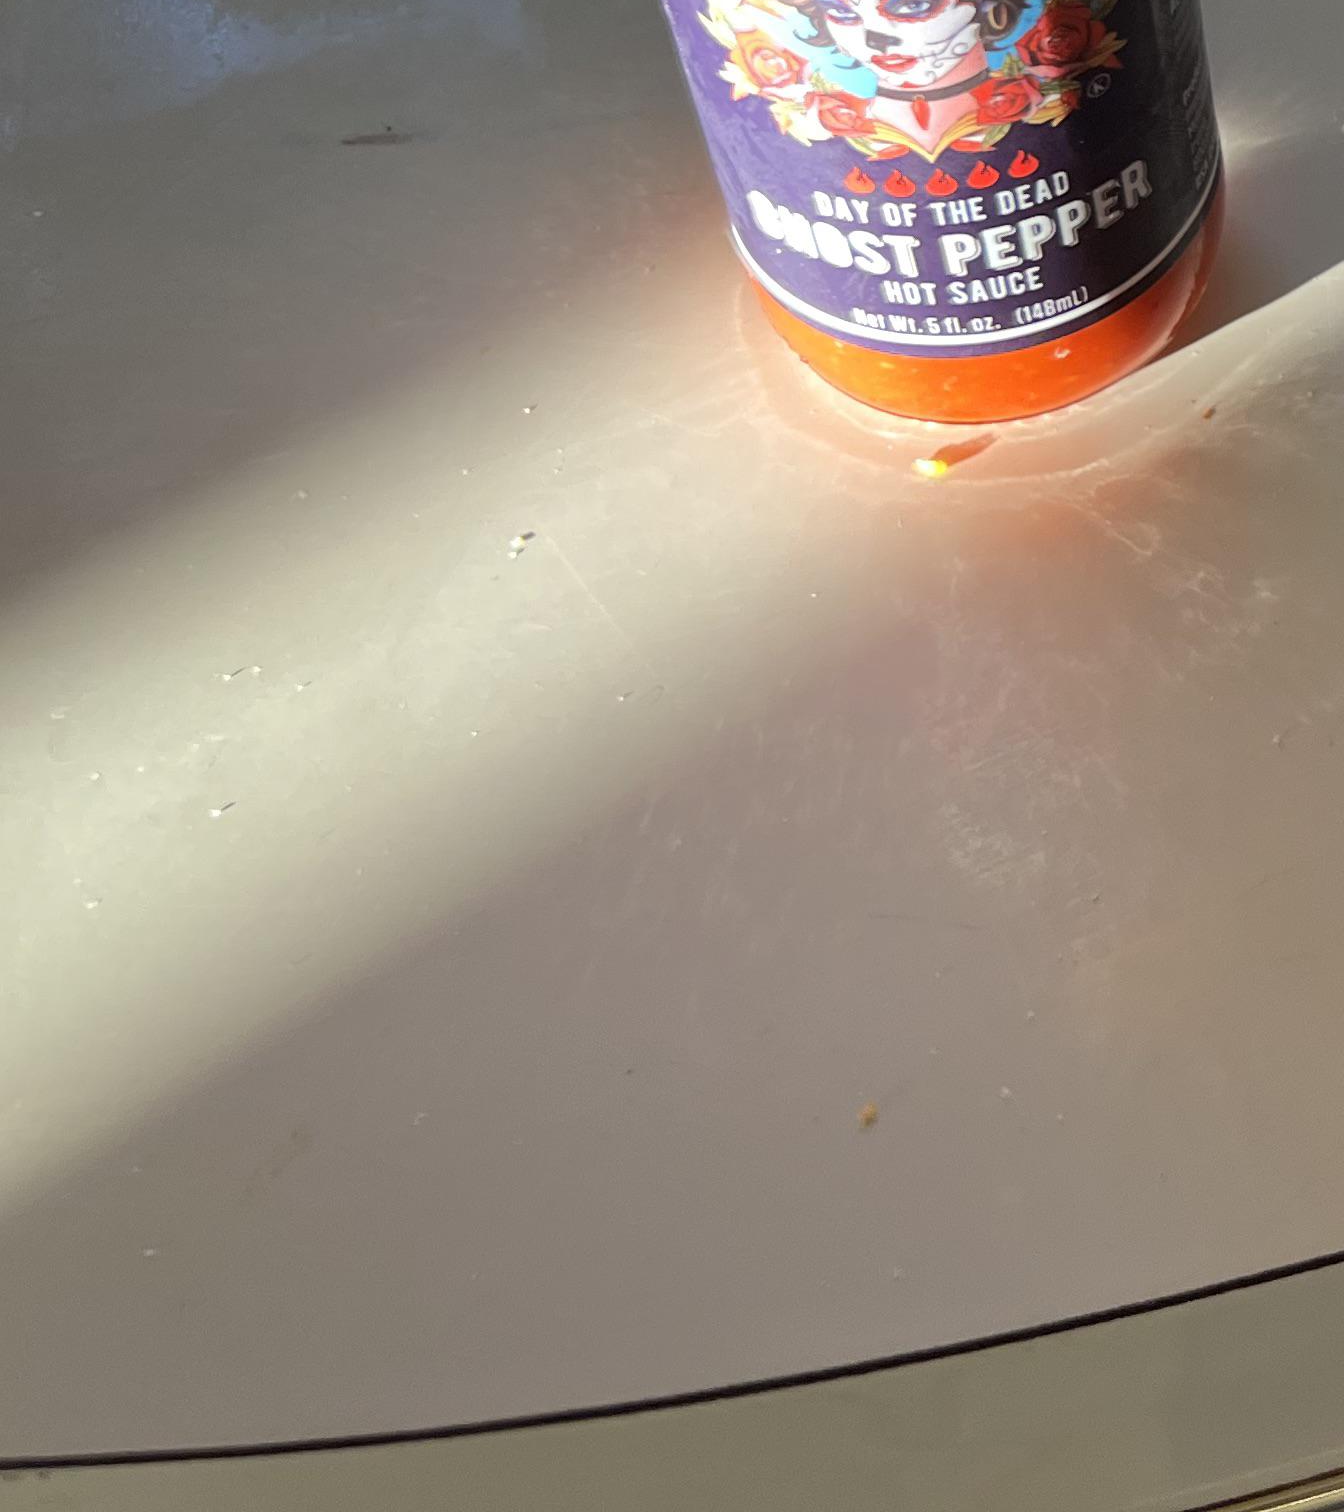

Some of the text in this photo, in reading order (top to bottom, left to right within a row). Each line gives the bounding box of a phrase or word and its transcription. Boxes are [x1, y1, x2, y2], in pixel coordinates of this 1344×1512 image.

[813, 171, 1070, 228] DAY OF THE DEAD
[939, 159, 1152, 277] PEPPER
[882, 266, 1044, 306] HOT SAUCE
[925, 316, 941, 334] 5
[970, 316, 1002, 333] oz.
[1014, 286, 1089, 325] (148mL)
